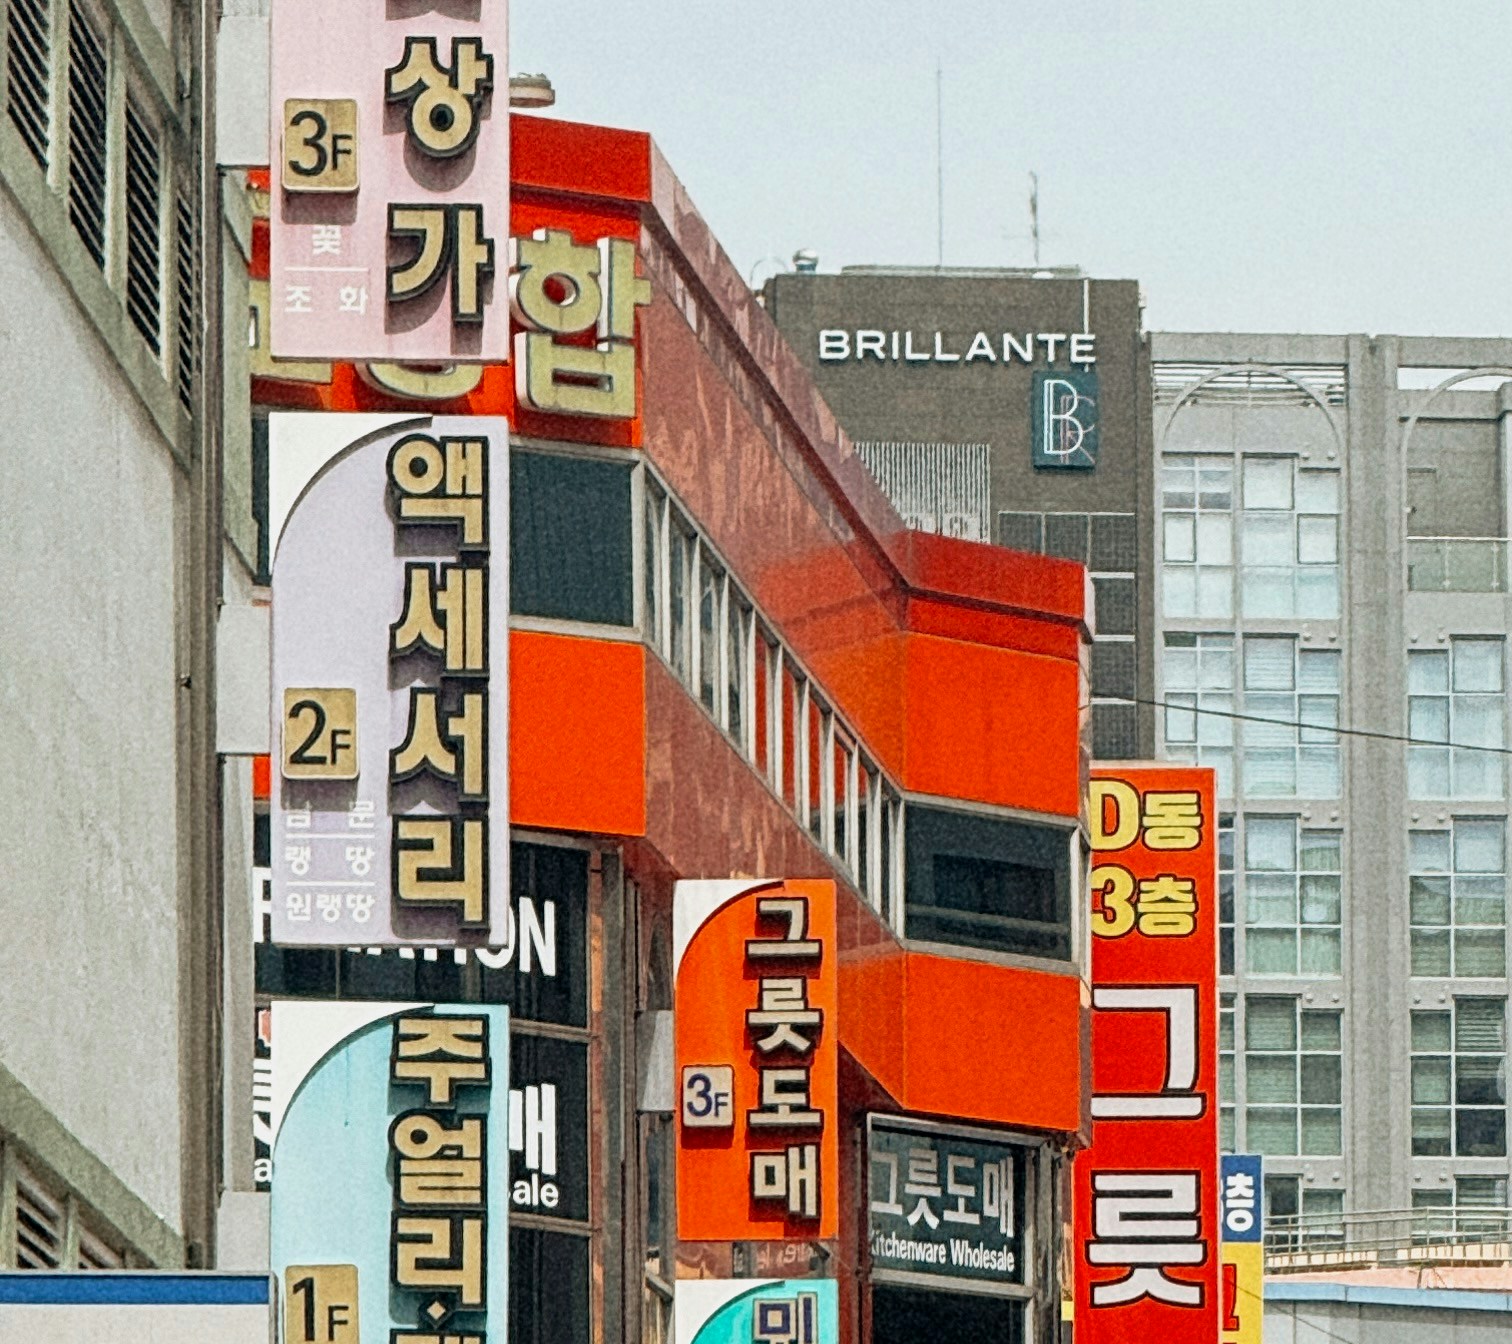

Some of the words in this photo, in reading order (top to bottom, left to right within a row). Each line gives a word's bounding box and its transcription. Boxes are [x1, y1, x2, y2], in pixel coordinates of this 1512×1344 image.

[287, 110, 353, 177] 3F
[385, 36, 494, 323] 상가
[818, 330, 1096, 364] BRILLANTE
[386, 434, 490, 928] 액세서리
[288, 699, 352, 766] 2F
[1090, 781, 1201, 850] D동
[1090, 866, 1196, 938] 3층
[744, 896, 824, 1220] 그릇도매
[686, 1073, 729, 1118] 3F
[872, 1146, 1015, 1238] 그릇도매
[949, 1243, 1015, 1273] Wholesale
[292, 1276, 350, 1343] 1F
